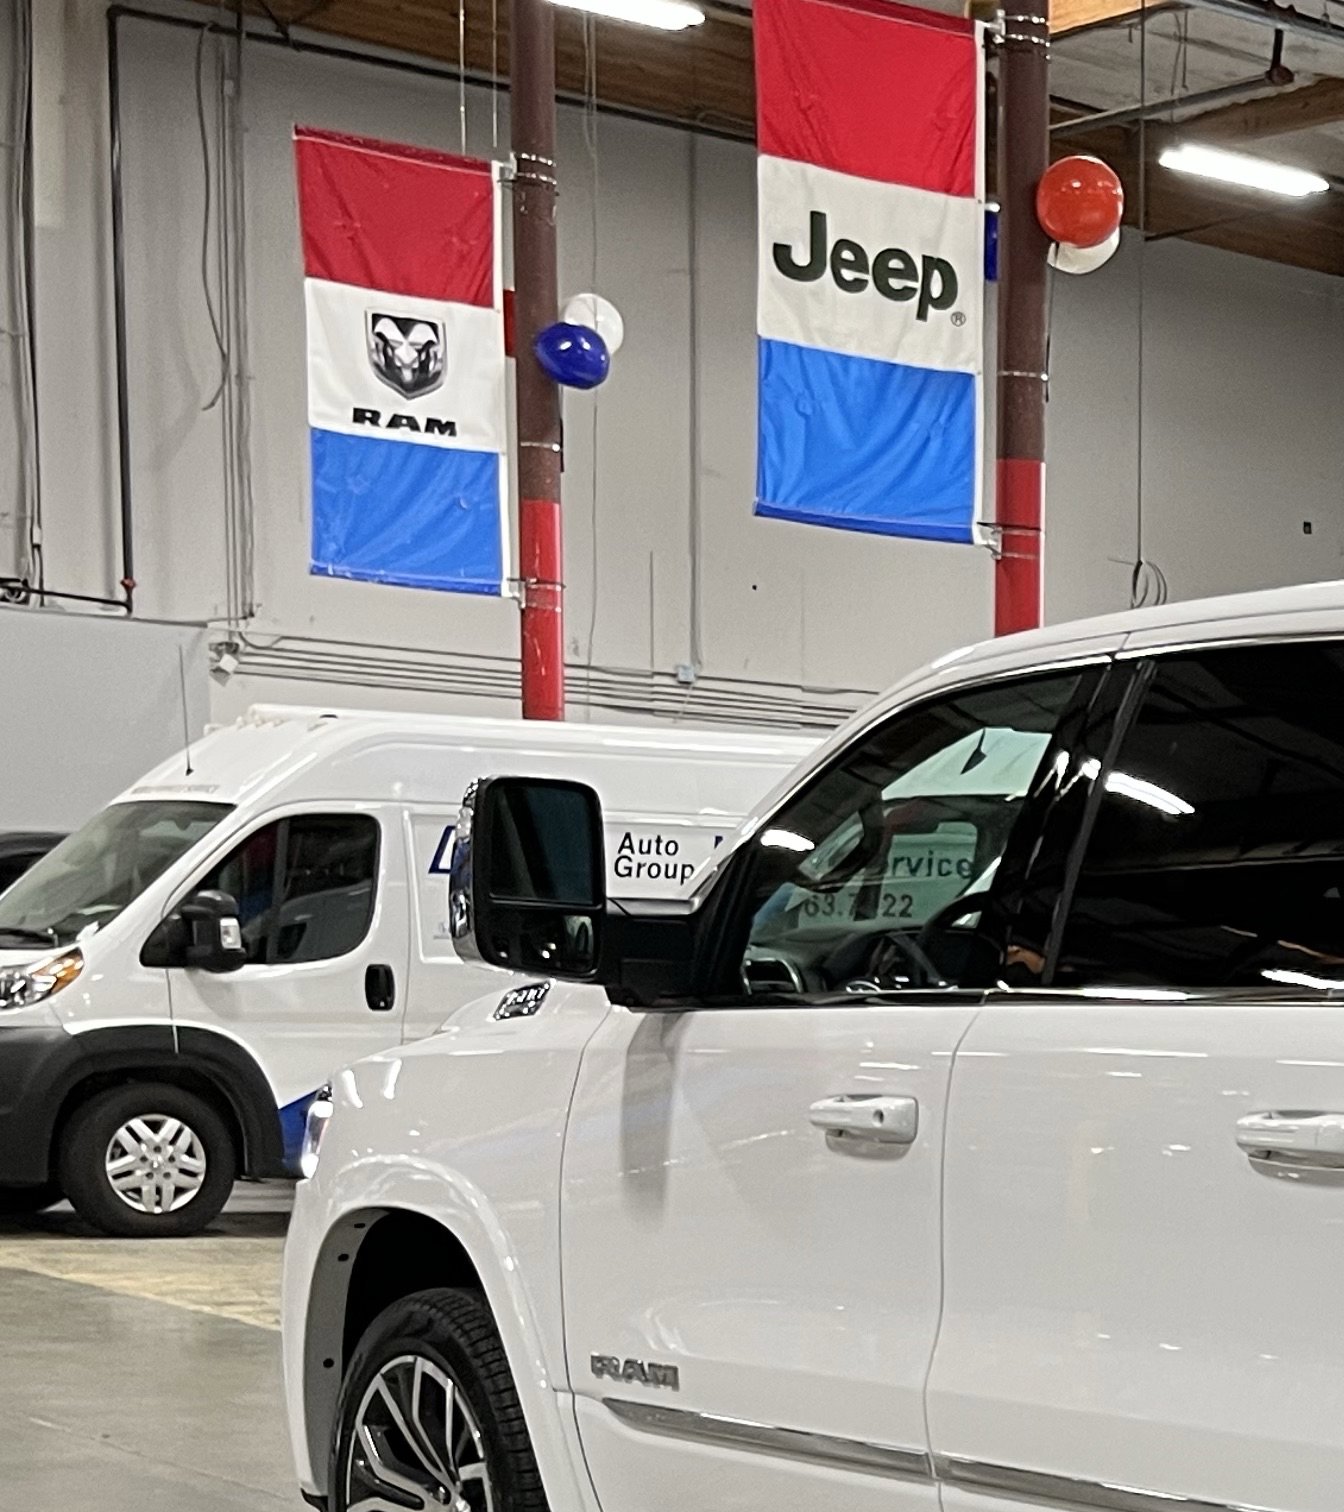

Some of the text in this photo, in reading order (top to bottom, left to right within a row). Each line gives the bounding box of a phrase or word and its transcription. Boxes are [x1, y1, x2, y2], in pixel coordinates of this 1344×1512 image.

[773, 210, 959, 322] Jeep
[352, 407, 457, 438] RAM
[617, 831, 679, 856] Auto
[613, 856, 695, 885] Group
[590, 1354, 680, 1391] RAM
